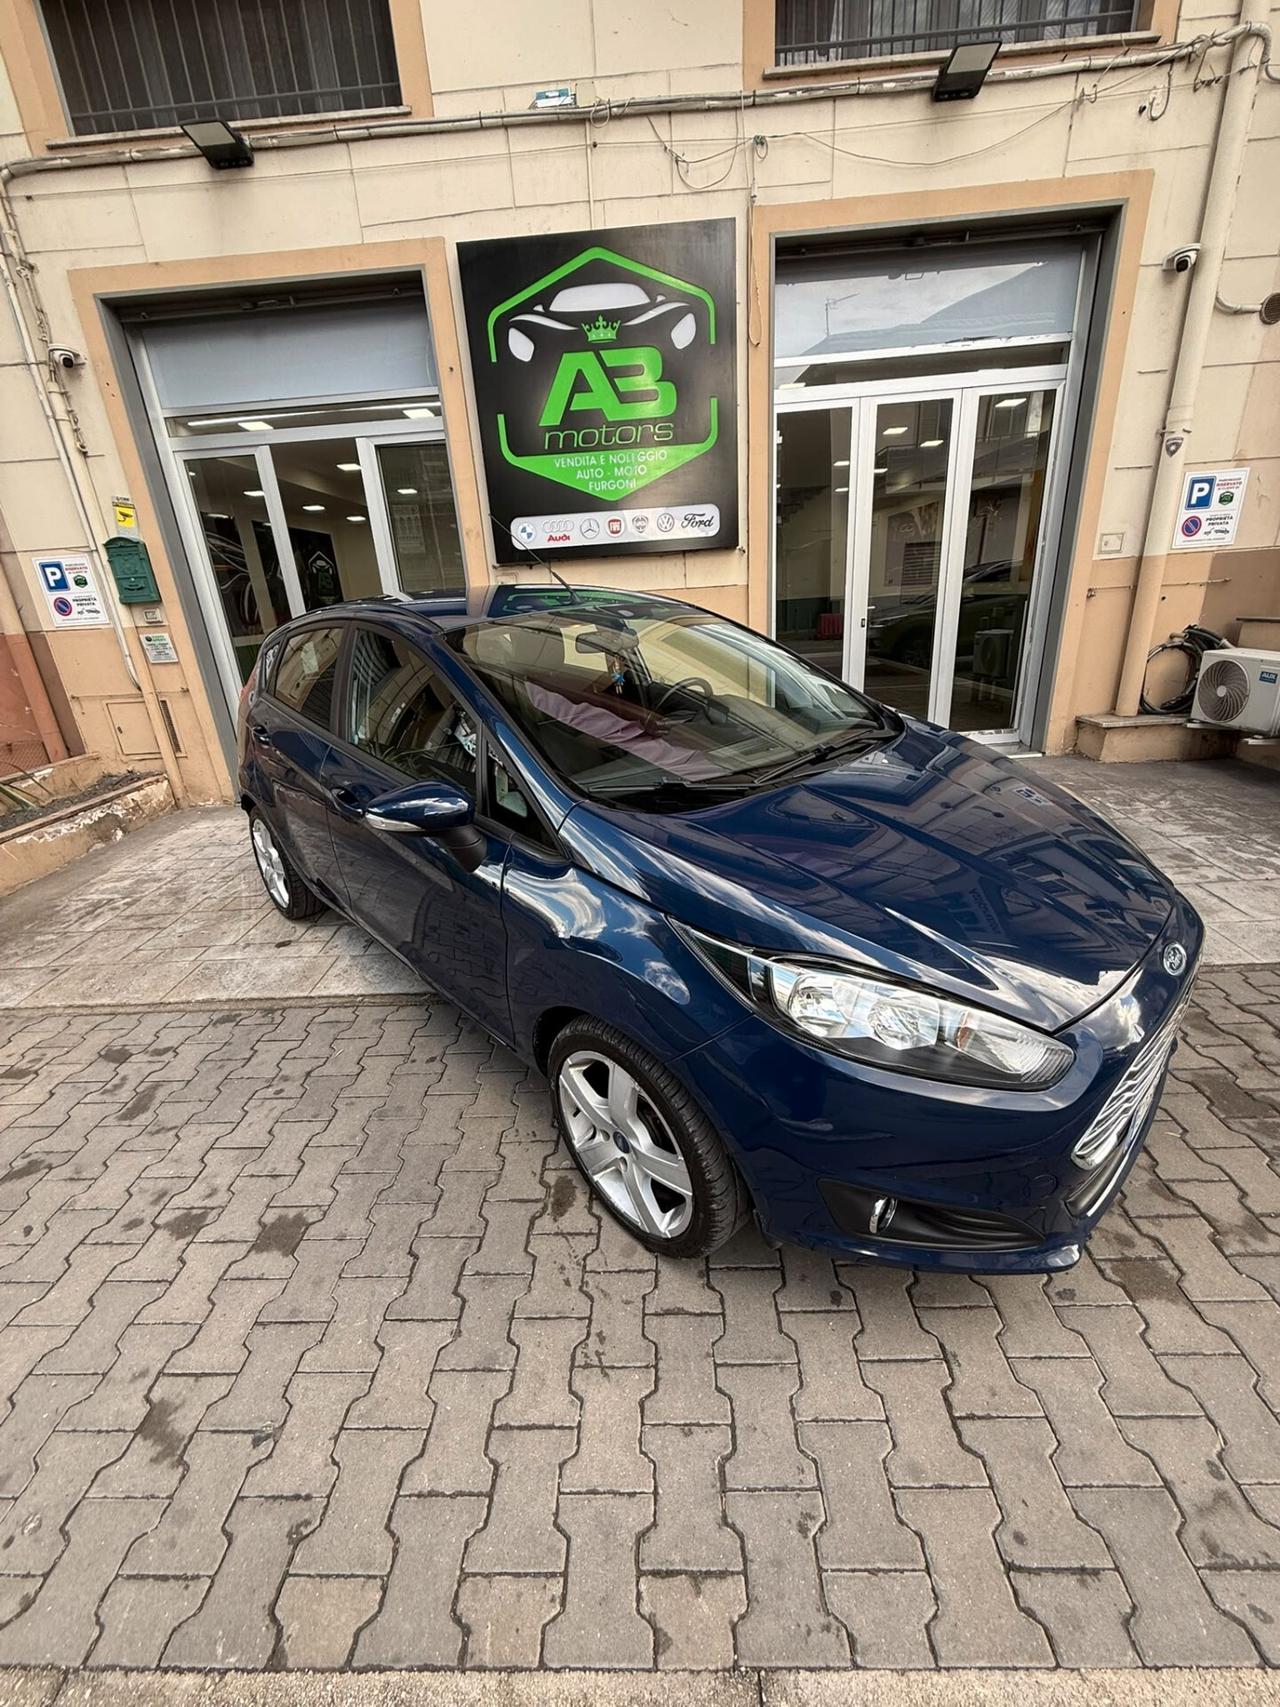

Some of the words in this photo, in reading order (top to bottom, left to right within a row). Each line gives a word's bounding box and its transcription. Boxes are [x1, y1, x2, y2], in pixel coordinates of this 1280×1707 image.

[544, 422, 674, 449] motors
[554, 455, 597, 468] VENDITA
[600, 454, 606, 465] E
[576, 468, 604, 479] AUTO
[614, 465, 647, 476] MOTO
[588, 478, 637, 491] FURGONI
[1190, 482, 1210, 505] P
[547, 534, 570, 543] Audi
[680, 513, 714, 529] Ford
[45, 566, 62, 587] P
